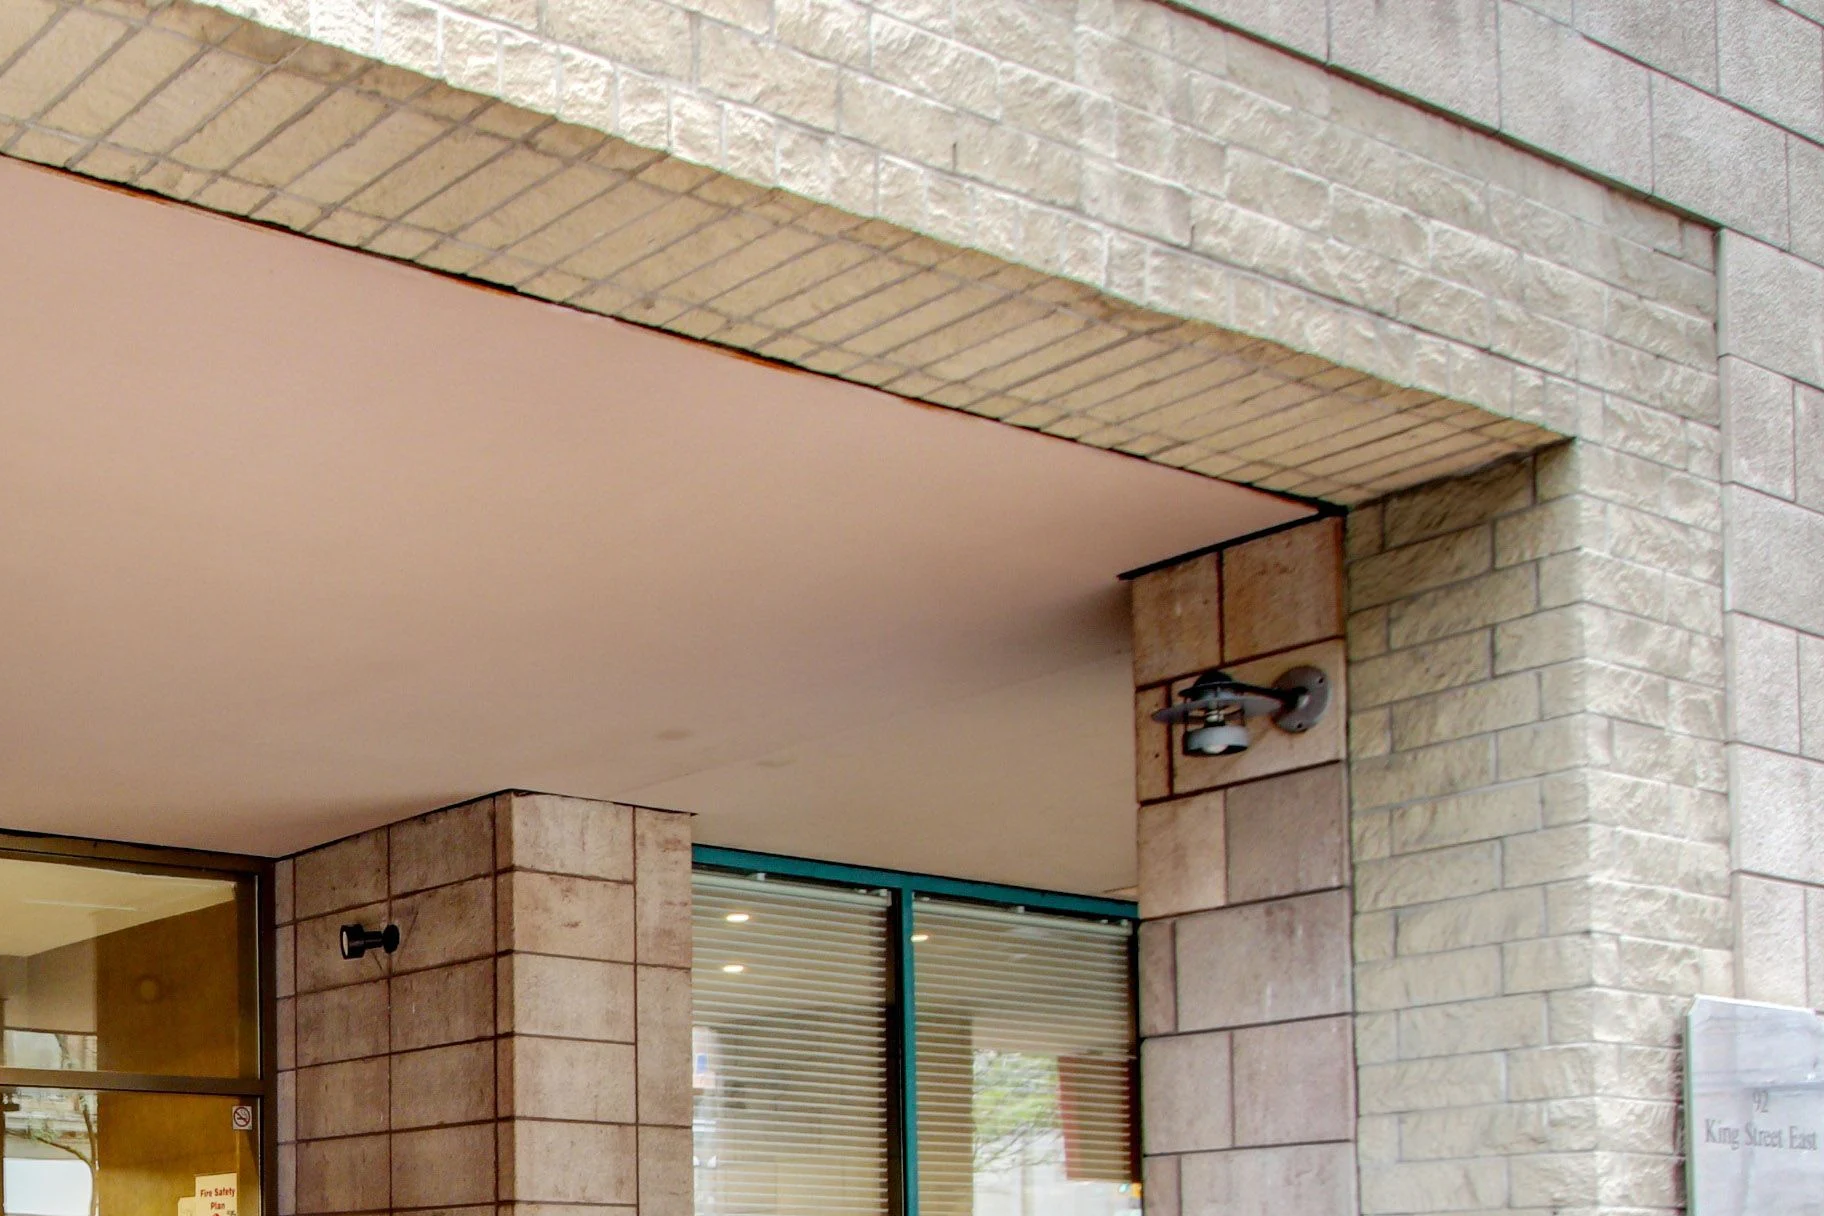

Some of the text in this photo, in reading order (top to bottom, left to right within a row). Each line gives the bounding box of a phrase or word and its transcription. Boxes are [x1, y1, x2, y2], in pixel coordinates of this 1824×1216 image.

[1753, 1089, 1769, 1113] 92
[1705, 1119, 1817, 1150] King Street East
[200, 1187, 236, 1197] Fire Safety
[210, 1202, 225, 1210] Plan
